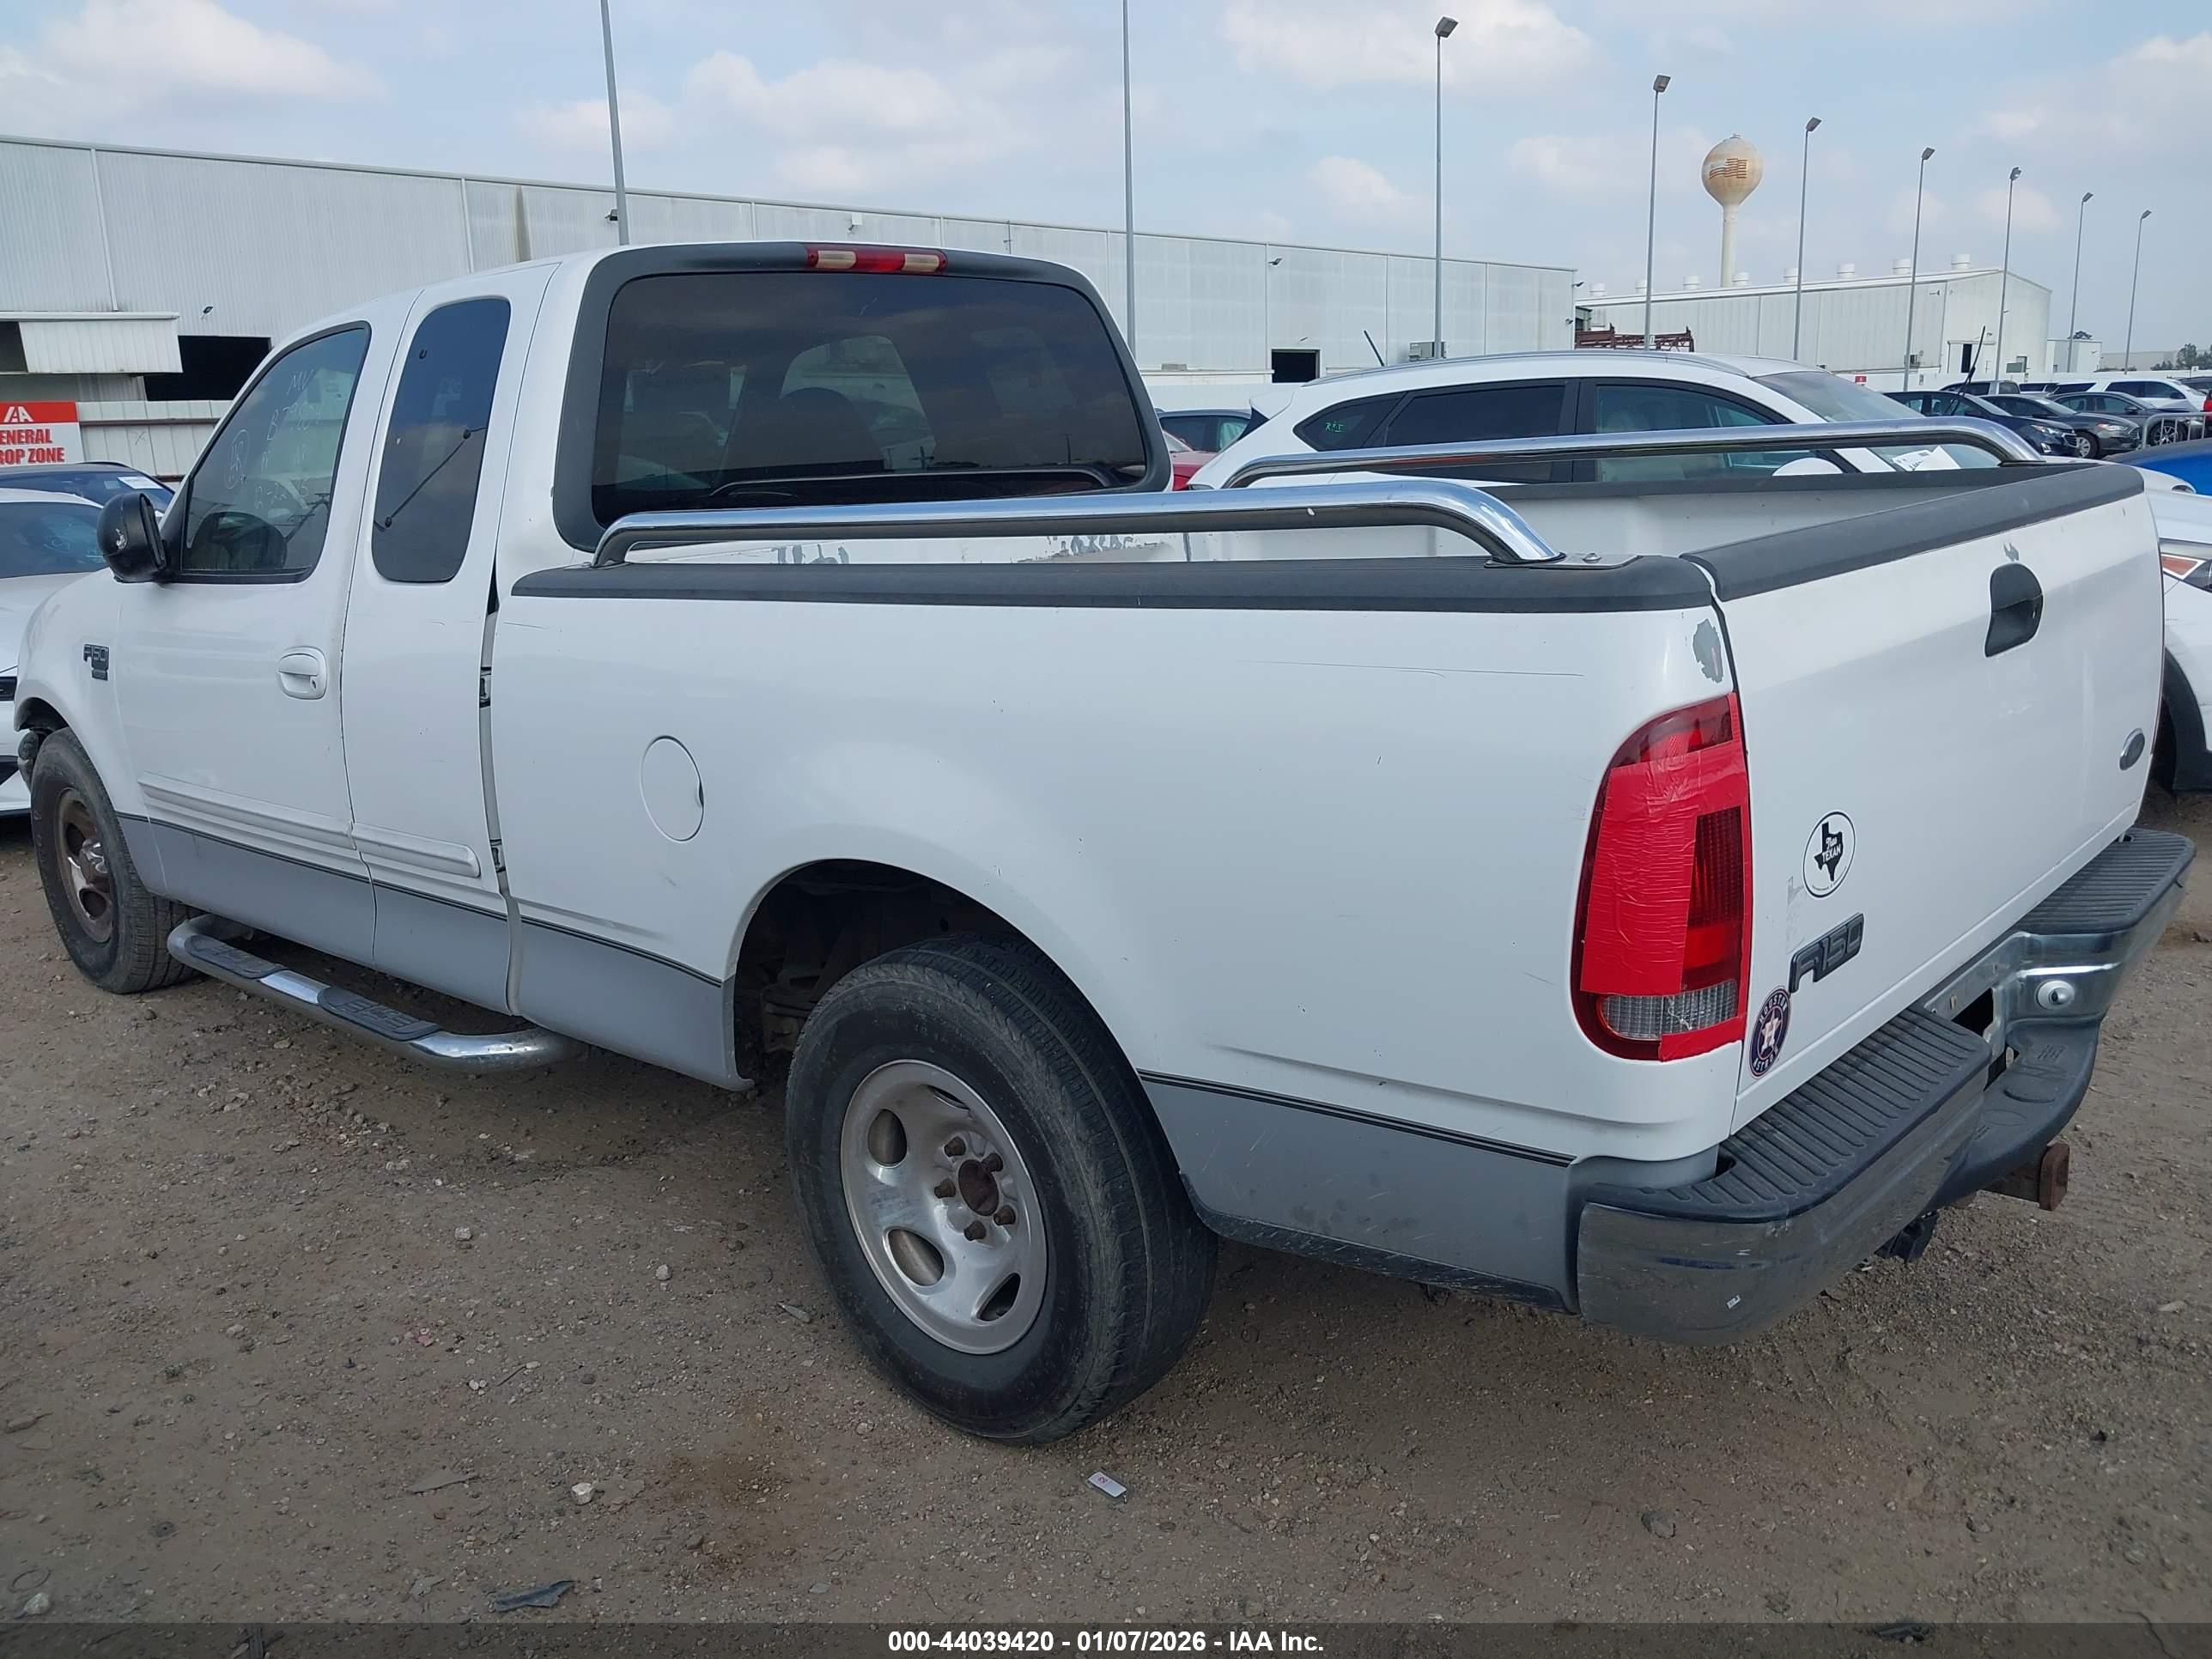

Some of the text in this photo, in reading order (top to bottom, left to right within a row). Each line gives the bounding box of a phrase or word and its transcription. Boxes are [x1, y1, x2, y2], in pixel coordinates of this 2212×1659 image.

[27, 447, 65, 463] ZONE
[1822, 844, 1842, 863] TEXAN
[1789, 913, 1863, 993] F150
[1759, 994, 1788, 1024] HOUSTON
[1753, 1044, 1778, 1072] ASTROS
